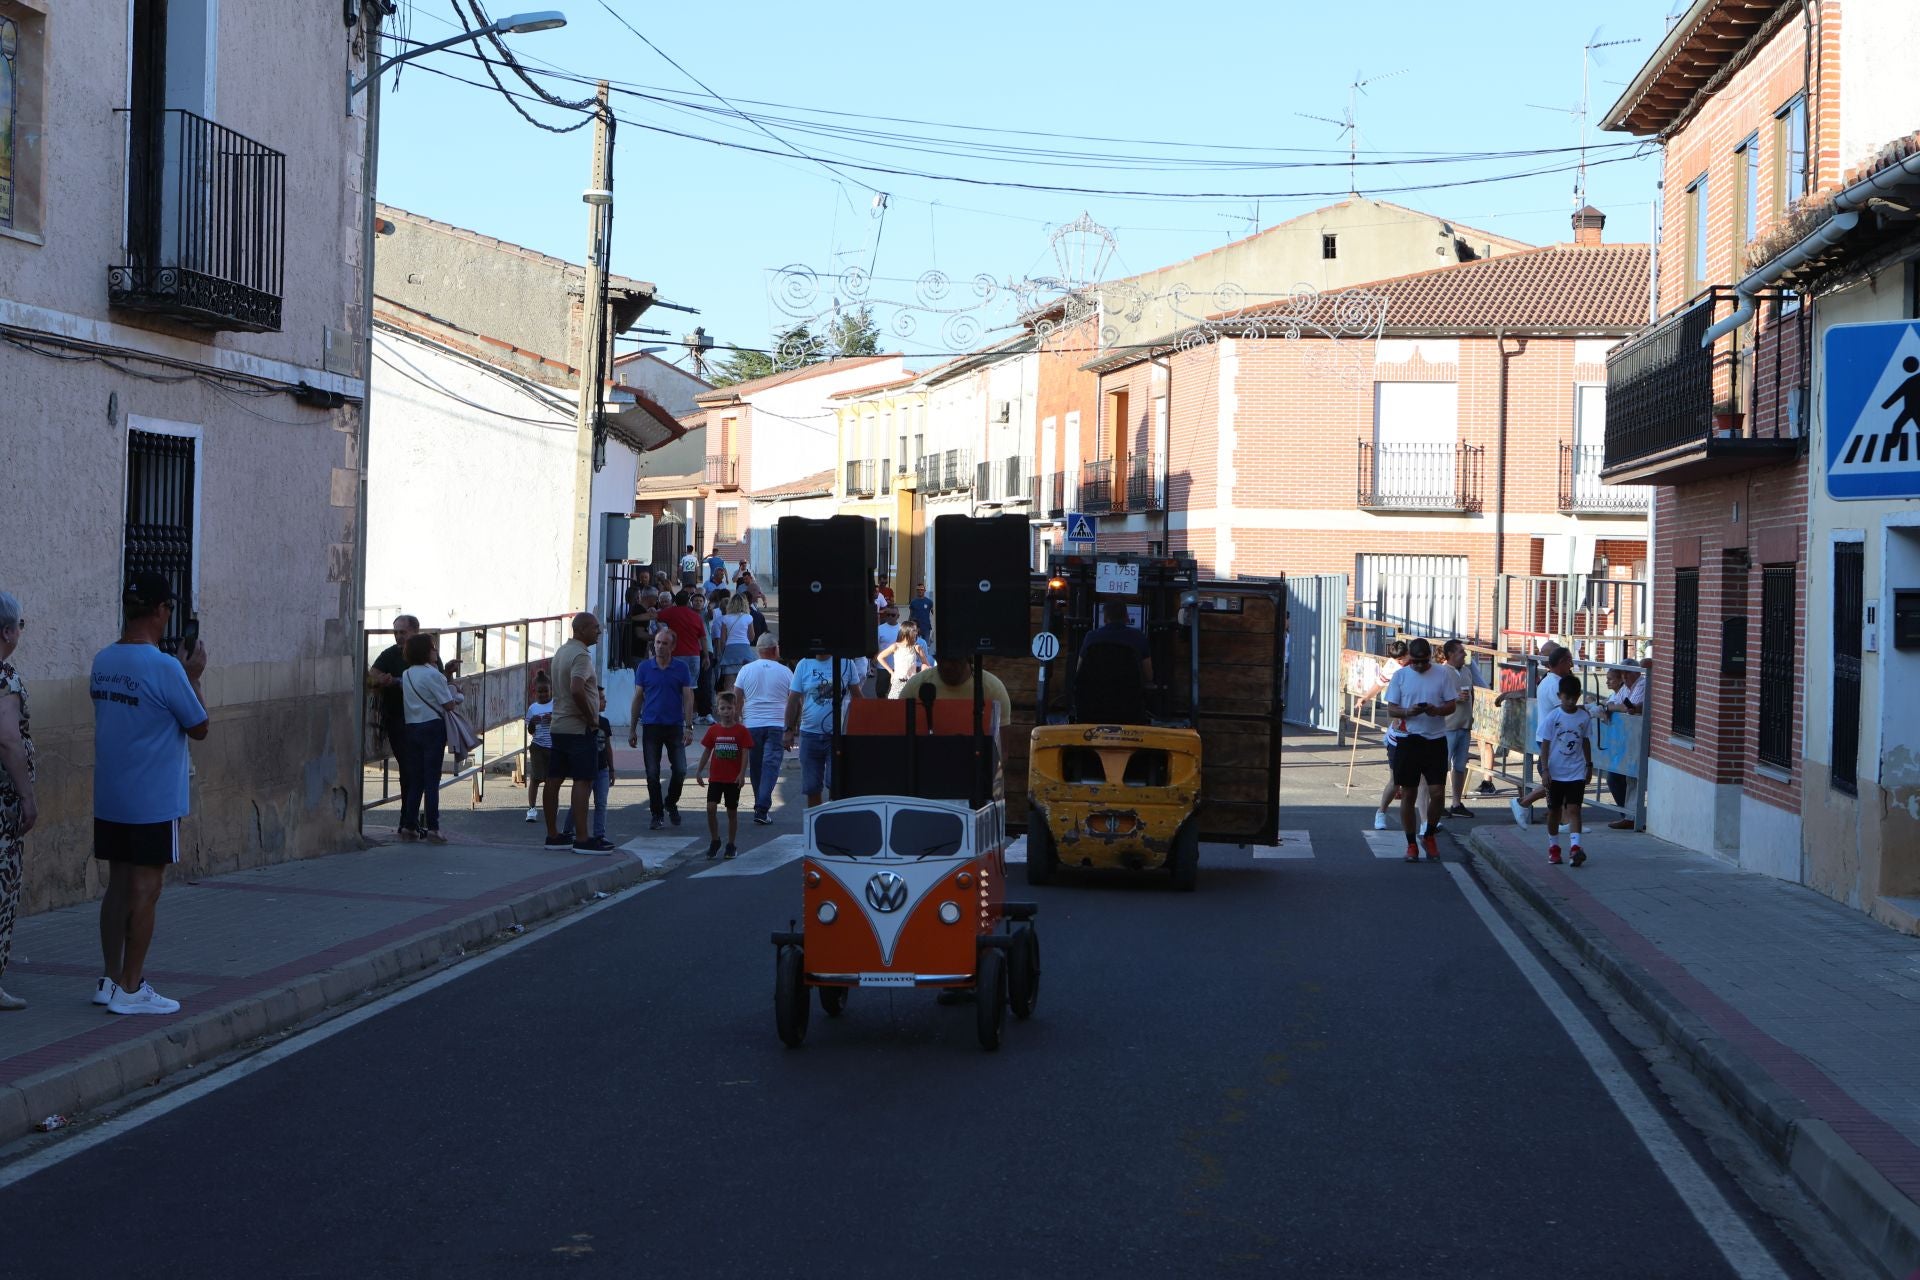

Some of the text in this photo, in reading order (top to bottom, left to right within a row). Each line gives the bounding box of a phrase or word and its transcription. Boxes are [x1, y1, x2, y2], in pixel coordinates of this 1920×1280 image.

[686, 561, 696, 570] 22
[1104, 565, 1111, 575] E
[1038, 634, 1053, 658] 20
[111, 672, 122, 684] del
[121, 674, 140, 691] Rey
